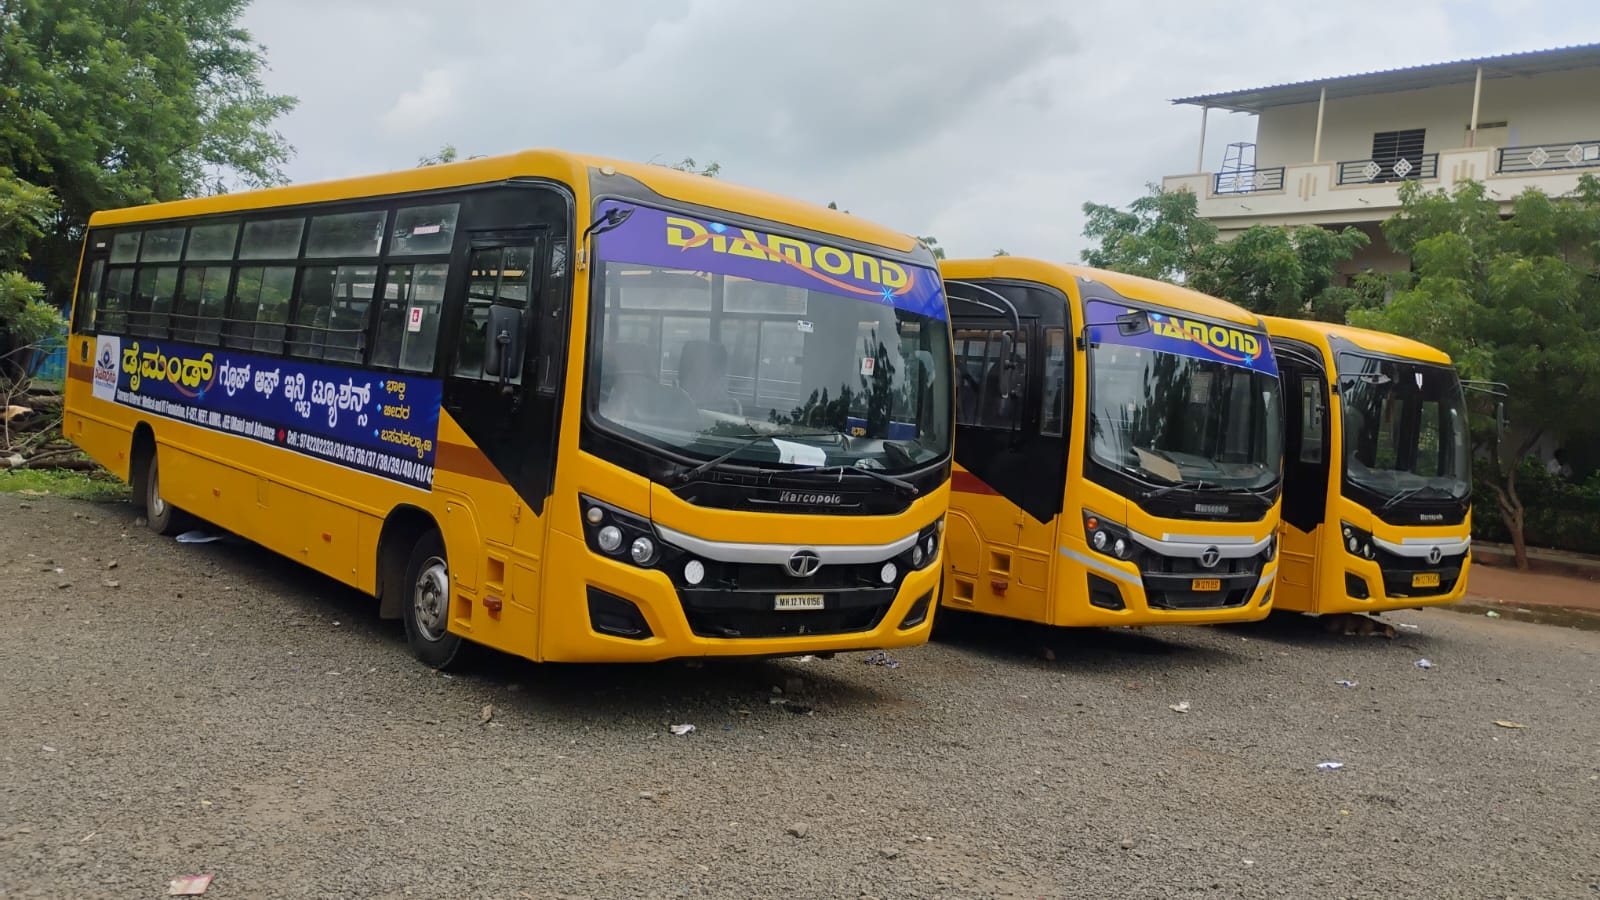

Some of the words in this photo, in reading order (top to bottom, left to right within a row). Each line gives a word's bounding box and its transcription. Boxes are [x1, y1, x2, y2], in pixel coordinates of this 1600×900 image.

[1128, 308, 1259, 356] IAMOND
[122, 341, 213, 391] ಡೈಮಂಡ್
[780, 490, 840, 505] Marcopolo
